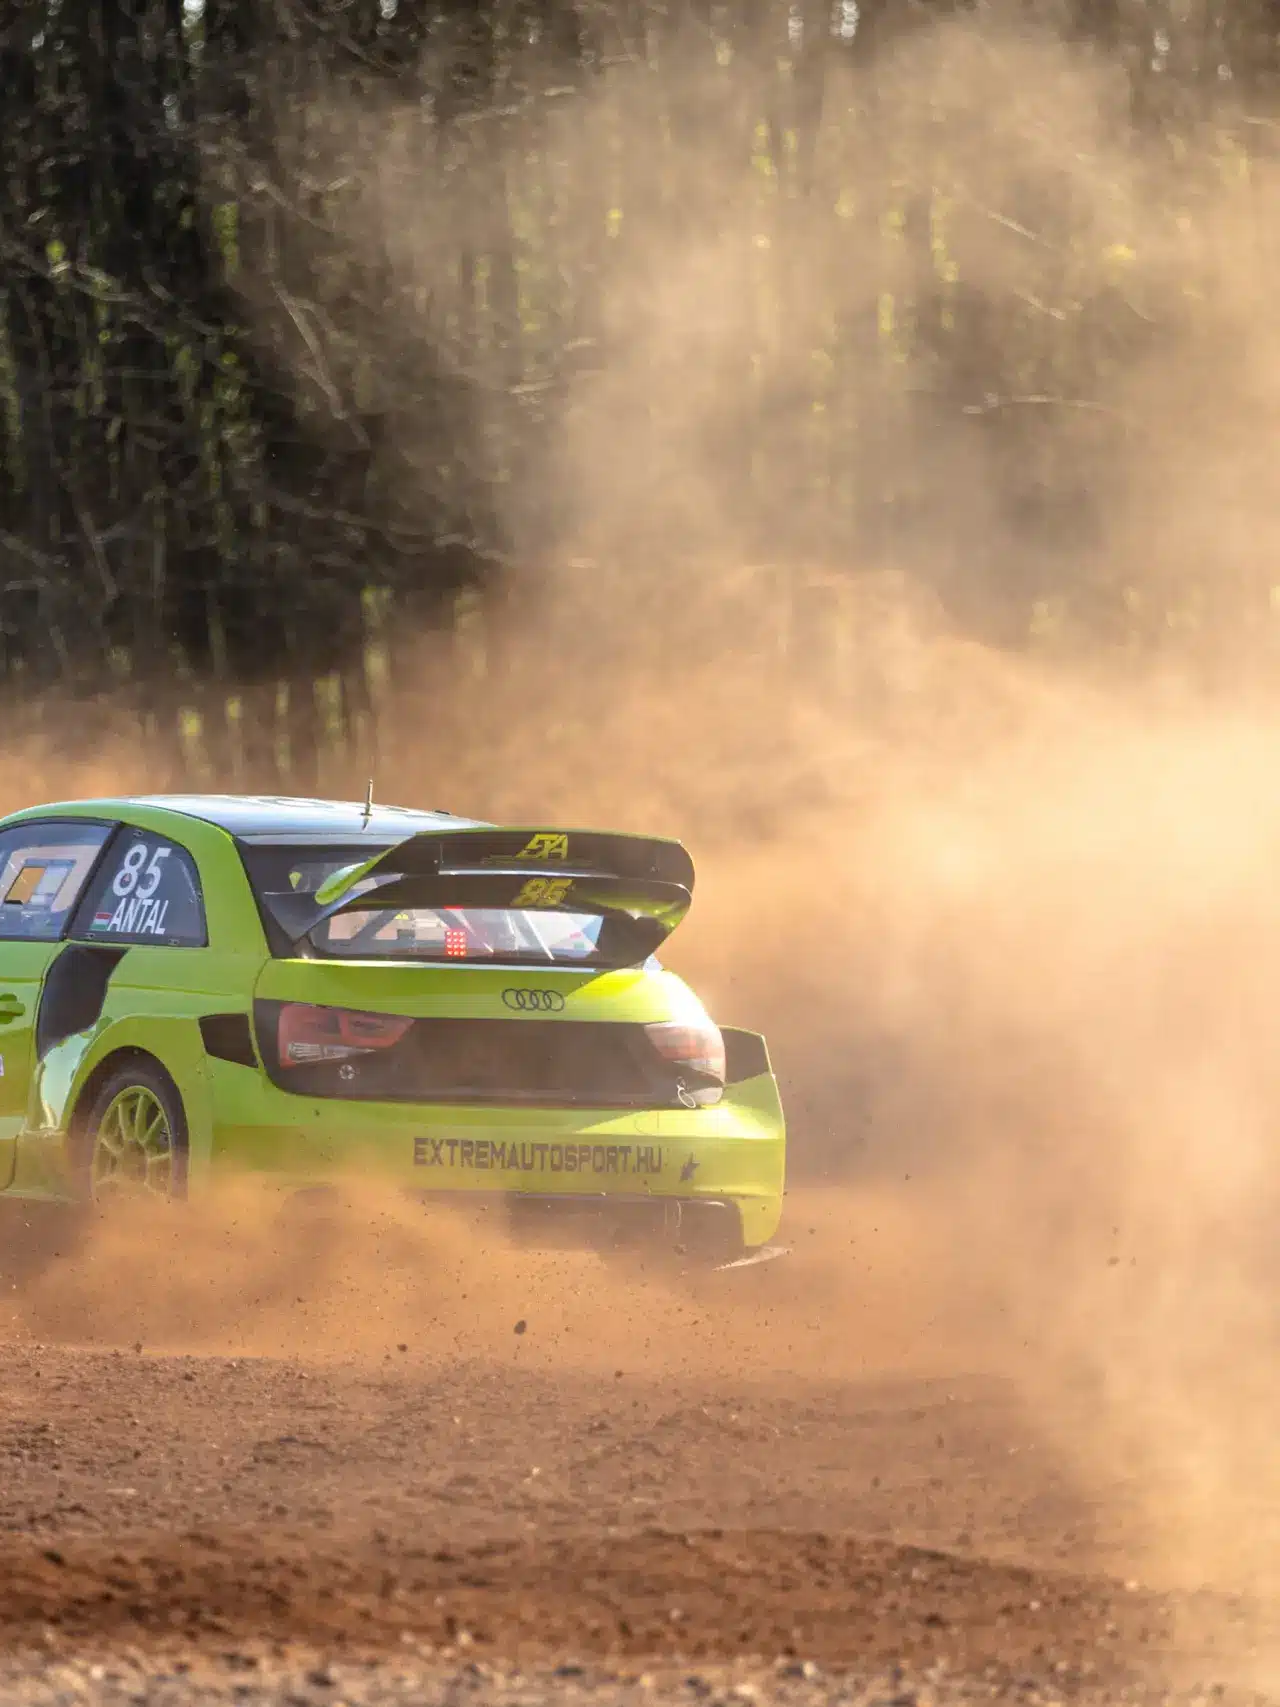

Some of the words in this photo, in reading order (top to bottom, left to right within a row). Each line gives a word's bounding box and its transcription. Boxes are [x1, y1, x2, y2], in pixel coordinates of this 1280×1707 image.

[113, 844, 172, 898] 85
[107, 898, 168, 934] ANTAL
[414, 1138, 662, 1173] EXTREMAUTOSPORT.HU
